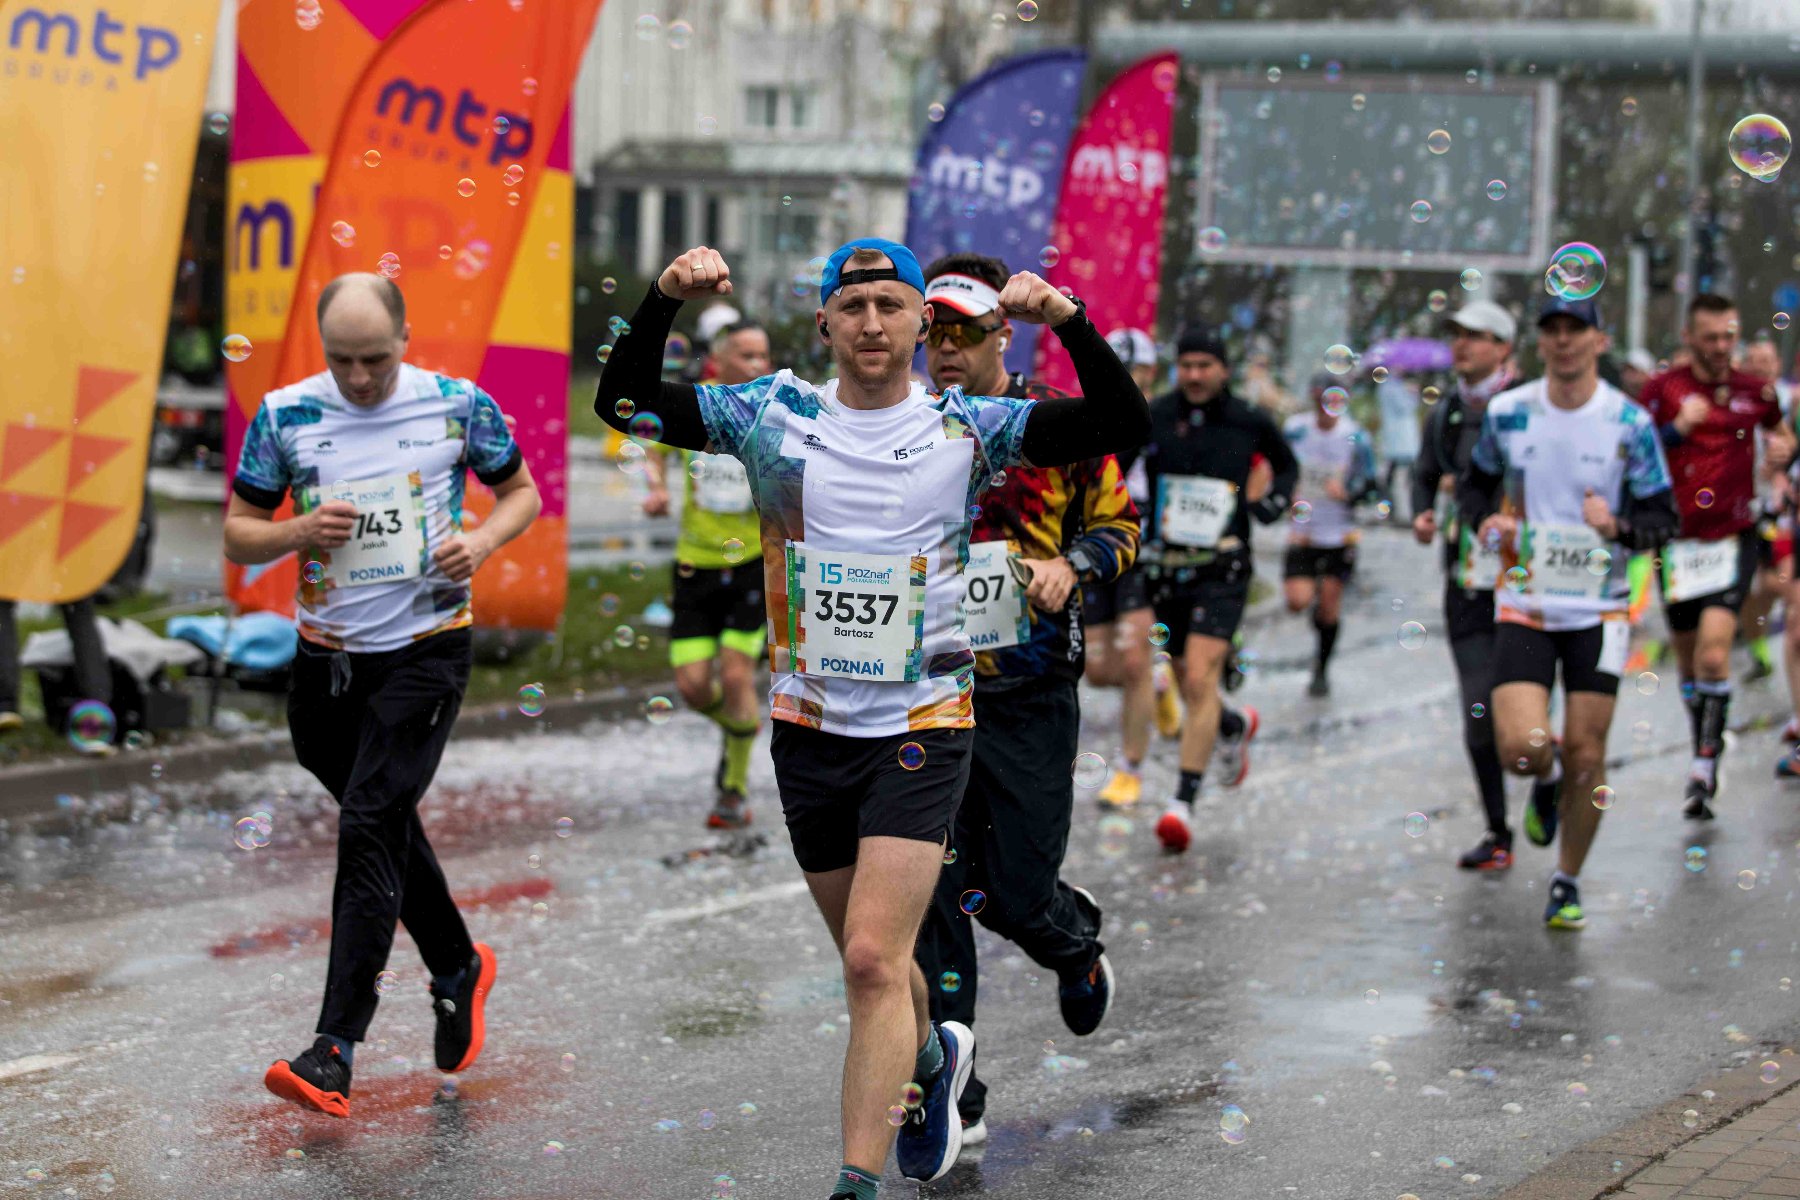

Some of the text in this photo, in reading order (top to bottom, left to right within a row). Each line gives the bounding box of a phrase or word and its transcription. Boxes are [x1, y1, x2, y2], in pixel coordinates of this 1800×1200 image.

[9, 8, 181, 80] mtp
[376, 77, 533, 166] mtp
[1072, 144, 1168, 191] mtp
[929, 152, 1043, 206] mtp
[894, 448, 908, 460] 15
[361, 540, 388, 551] Jakub
[350, 562, 405, 580] POZNAŃ
[819, 562, 843, 584] 15
[962, 574, 1005, 603] 07
[815, 590, 899, 625] 3537
[834, 627, 874, 639] Bartosz
[970, 629, 999, 645] NAŃ
[821, 657, 885, 676] POZNAŃ
